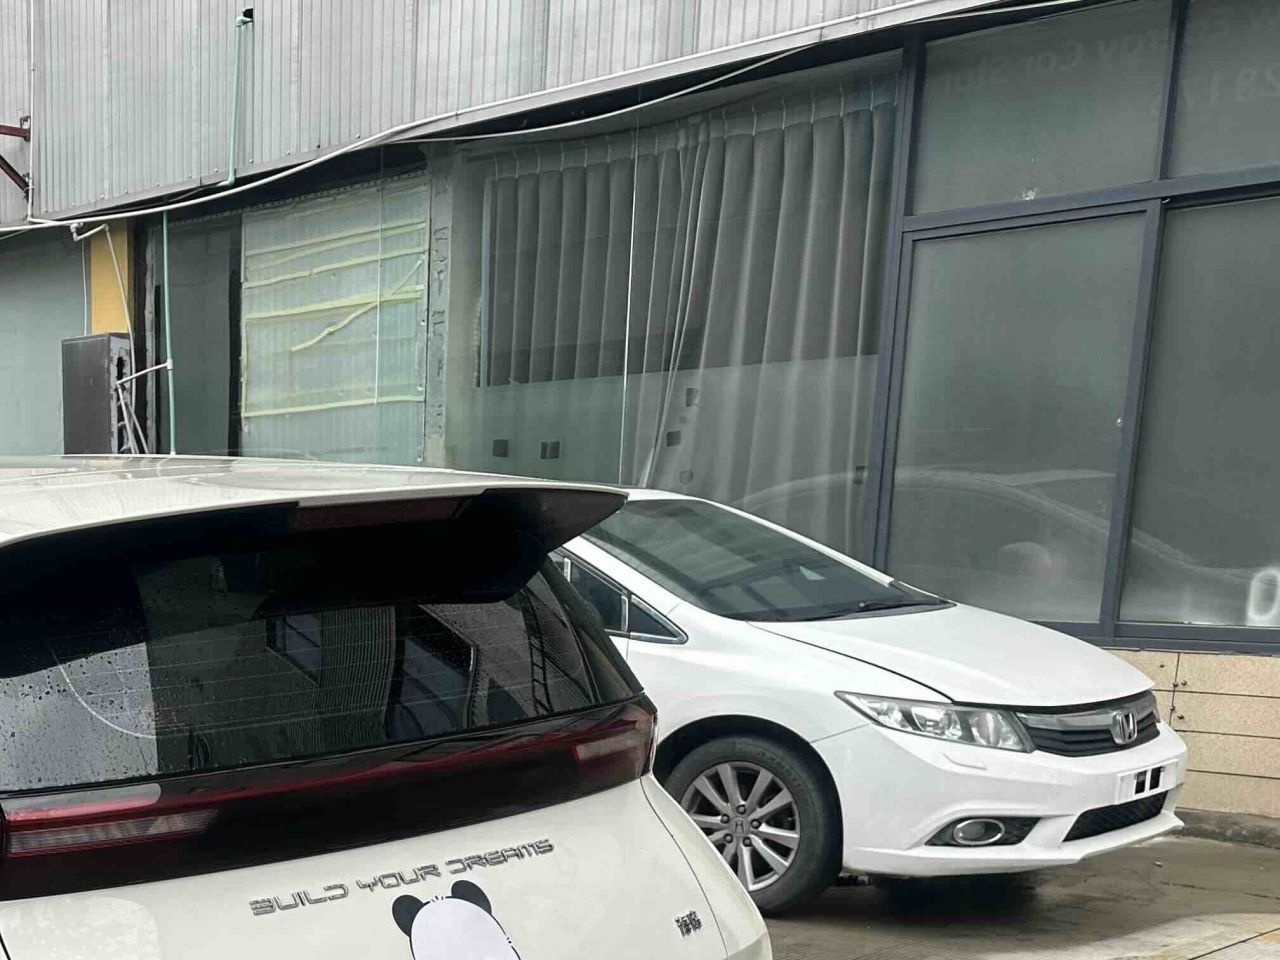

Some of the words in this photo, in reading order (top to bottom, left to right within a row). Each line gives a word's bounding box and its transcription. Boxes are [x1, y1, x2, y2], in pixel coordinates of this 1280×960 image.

[249, 882, 350, 916] BUILD
[356, 863, 442, 893] YOUR
[445, 839, 555, 875] DREAMS
